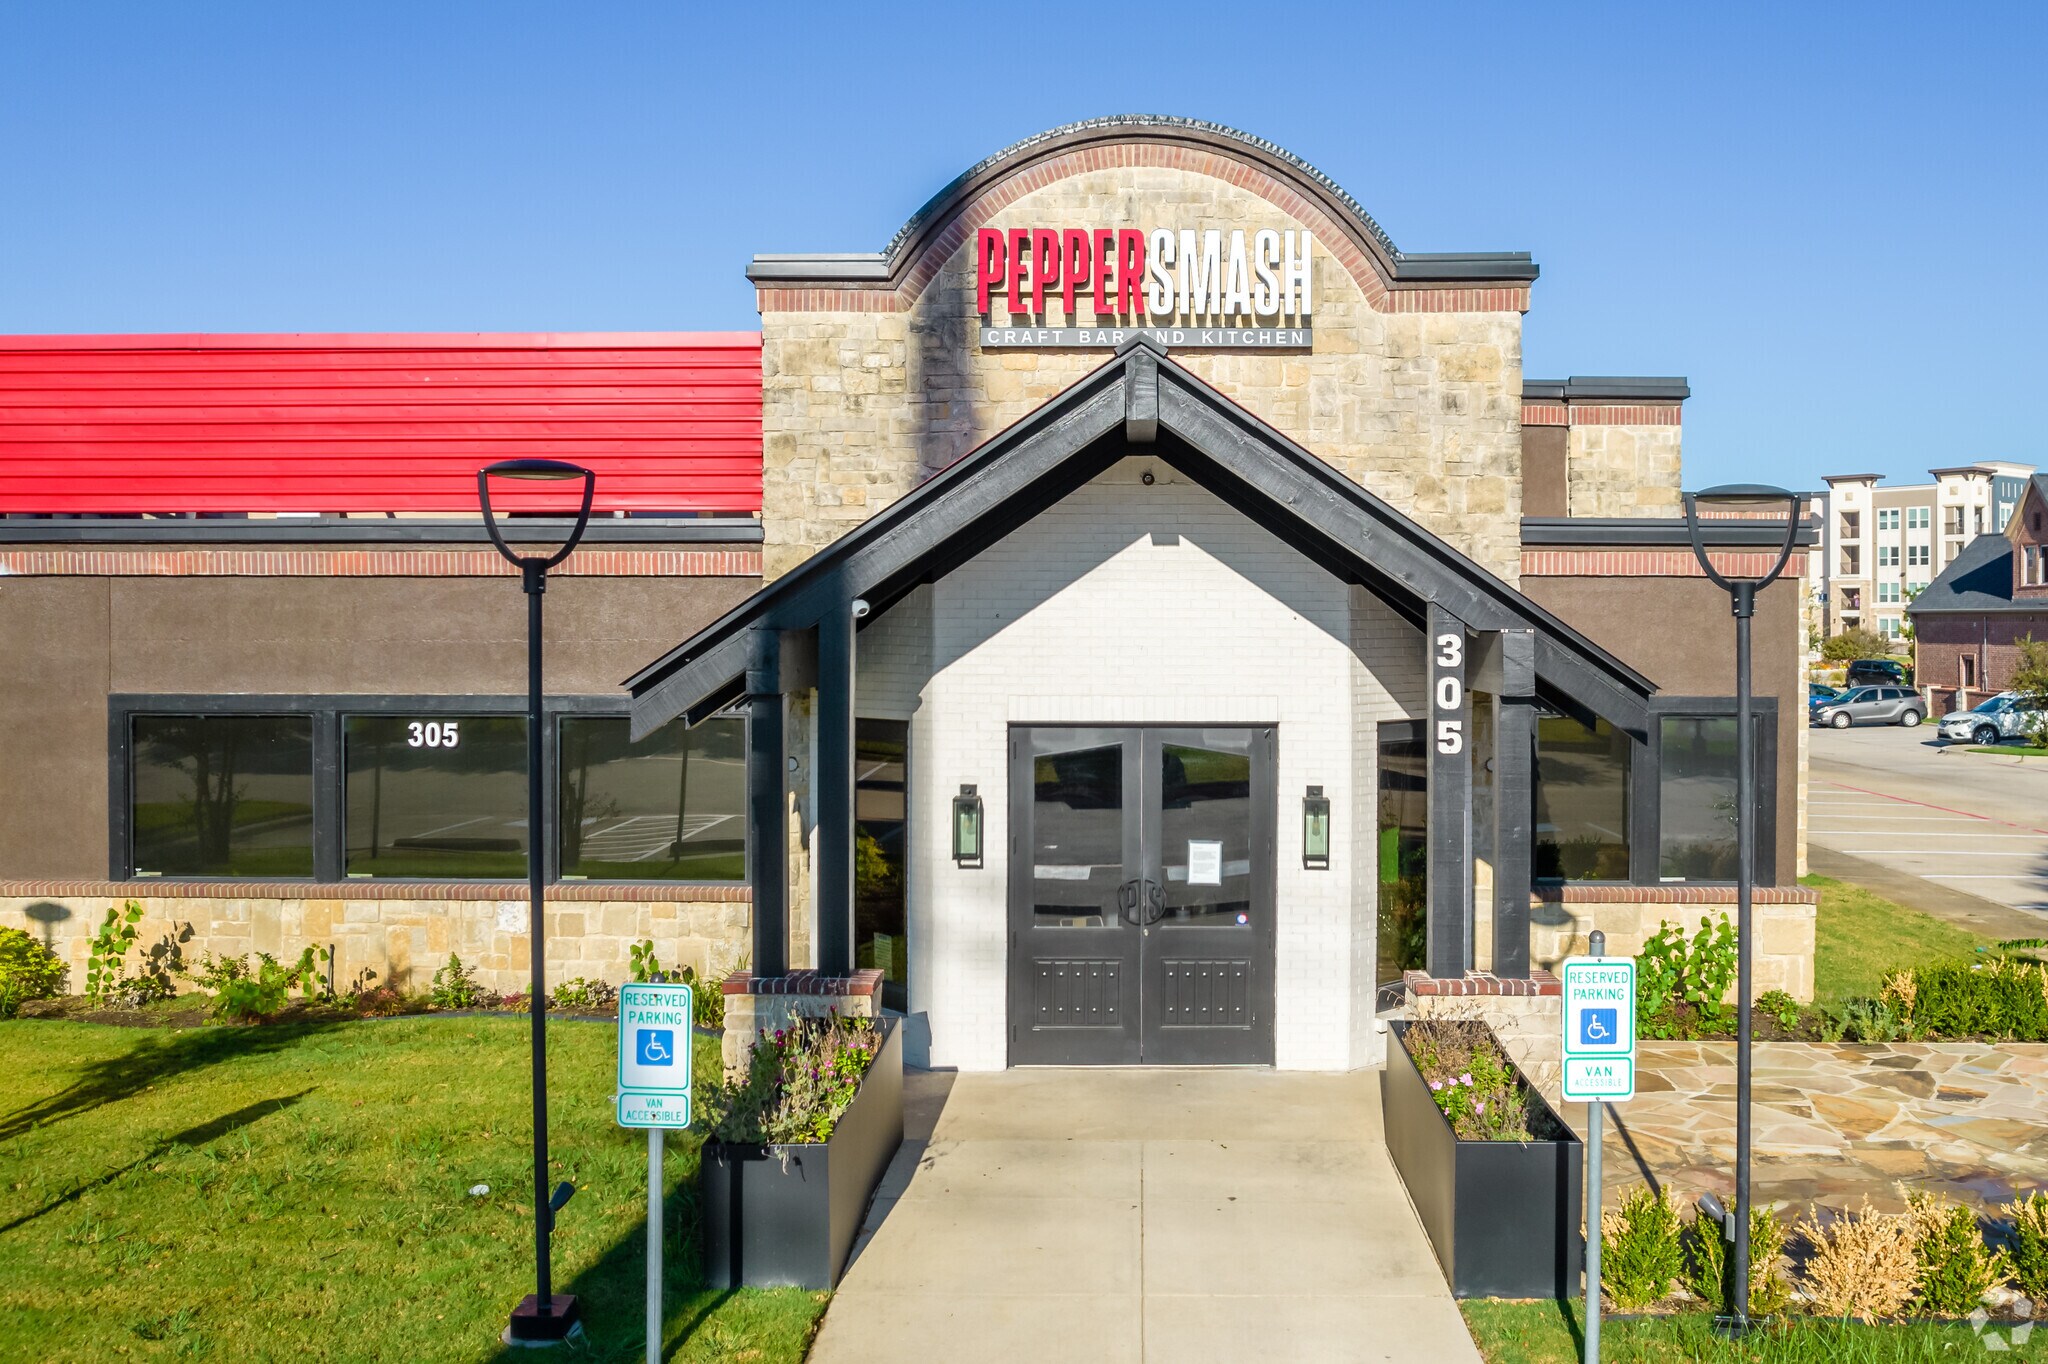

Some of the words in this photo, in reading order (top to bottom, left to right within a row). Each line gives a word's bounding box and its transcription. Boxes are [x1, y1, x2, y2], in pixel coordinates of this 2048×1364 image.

[987, 330, 1063, 344] CRAFT
[1079, 330, 1125, 344] BAR
[1142, 330, 1185, 344] ND
[1202, 330, 1304, 345] KITCHEN
[407, 722, 459, 747] 305
[1569, 972, 1628, 984] RESERVED
[625, 993, 687, 1007] RESERVED
[1574, 989, 1624, 1000] PARKING
[628, 1011, 682, 1025] PARKING
[1585, 1066, 1613, 1077] VAN
[1575, 1077, 1622, 1087] ACCESSIBLE
[645, 1097, 663, 1109] VAN
[625, 1110, 682, 1122] ACCESSIBLE
